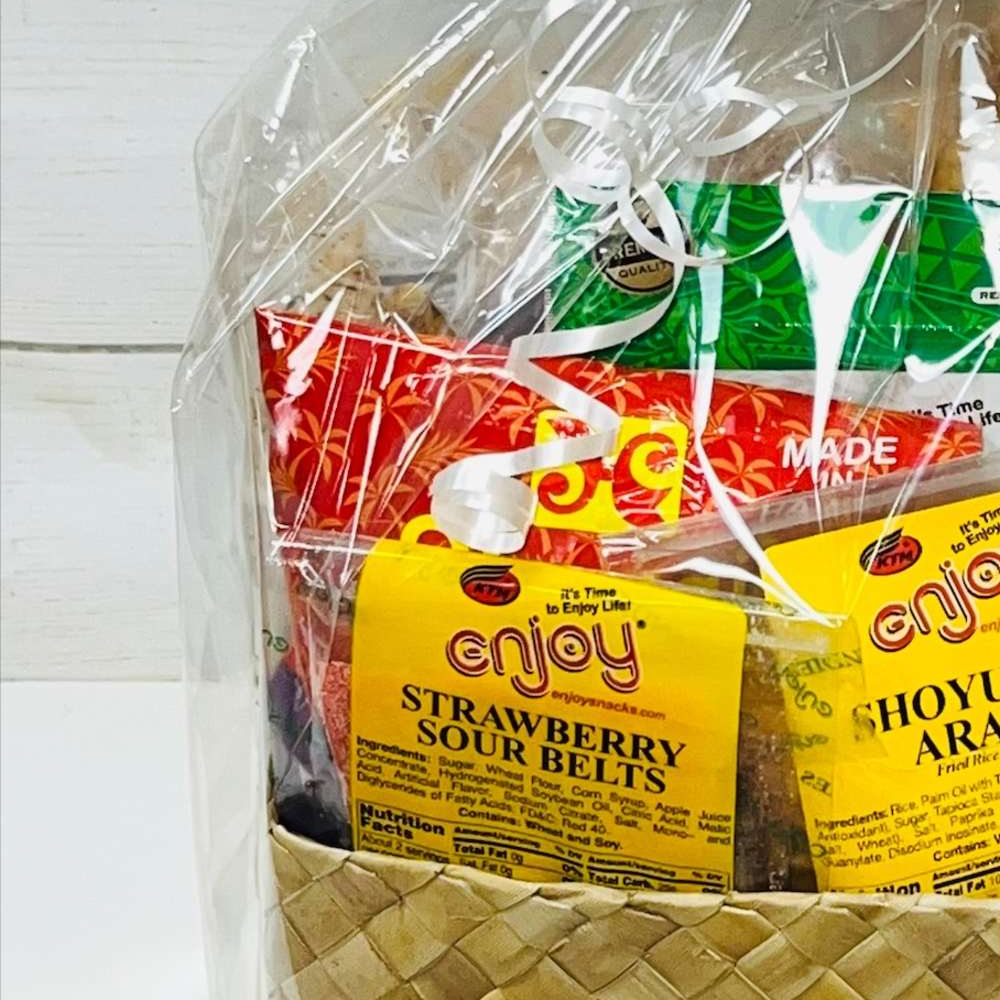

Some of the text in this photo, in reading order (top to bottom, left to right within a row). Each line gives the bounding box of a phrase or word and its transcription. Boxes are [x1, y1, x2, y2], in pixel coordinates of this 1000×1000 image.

[618, 262, 672, 279] QUALIT
[782, 436, 899, 469] MADE
[959, 520, 980, 536] It's
[950, 541, 967, 555] to
[584, 586, 617, 599] Time
[546, 600, 632, 617] to Enjoy Life!
[446, 615, 641, 699] enjoy
[551, 689, 667, 721] enjoysnacks.com
[401, 683, 688, 769] STRAWBERRY
[416, 718, 667, 795] SOUR BELTS
[937, 757, 969, 777] Fried
[973, 752, 999, 767] Rice
[356, 735, 431, 764] Ingredients:
[486, 763, 524, 781] Wheat
[571, 785, 602, 800] Corn
[655, 802, 690, 818] Apple
[699, 810, 731, 823] Juice
[439, 767, 524, 794] Hydrogenated
[531, 786, 584, 809] Soybean
[698, 821, 731, 834] Malic
[921, 791, 950, 805] Palm
[952, 784, 967, 798] Oil
[969, 778, 993, 793] with
[359, 803, 446, 836] Nutrition
[430, 790, 442, 801] of
[446, 792, 478, 807] Fatty
[562, 817, 588, 833] Red
[934, 798, 979, 818] Tapioca
[360, 816, 414, 840] Facts
[458, 806, 624, 850] Contains: Wheat and Soy.
[706, 834, 731, 846] and
[454, 843, 485, 857] Total
[488, 847, 508, 860] Fat
[888, 836, 943, 860] Disodium
[588, 872, 619, 886] Total
[966, 879, 987, 894] Fat
